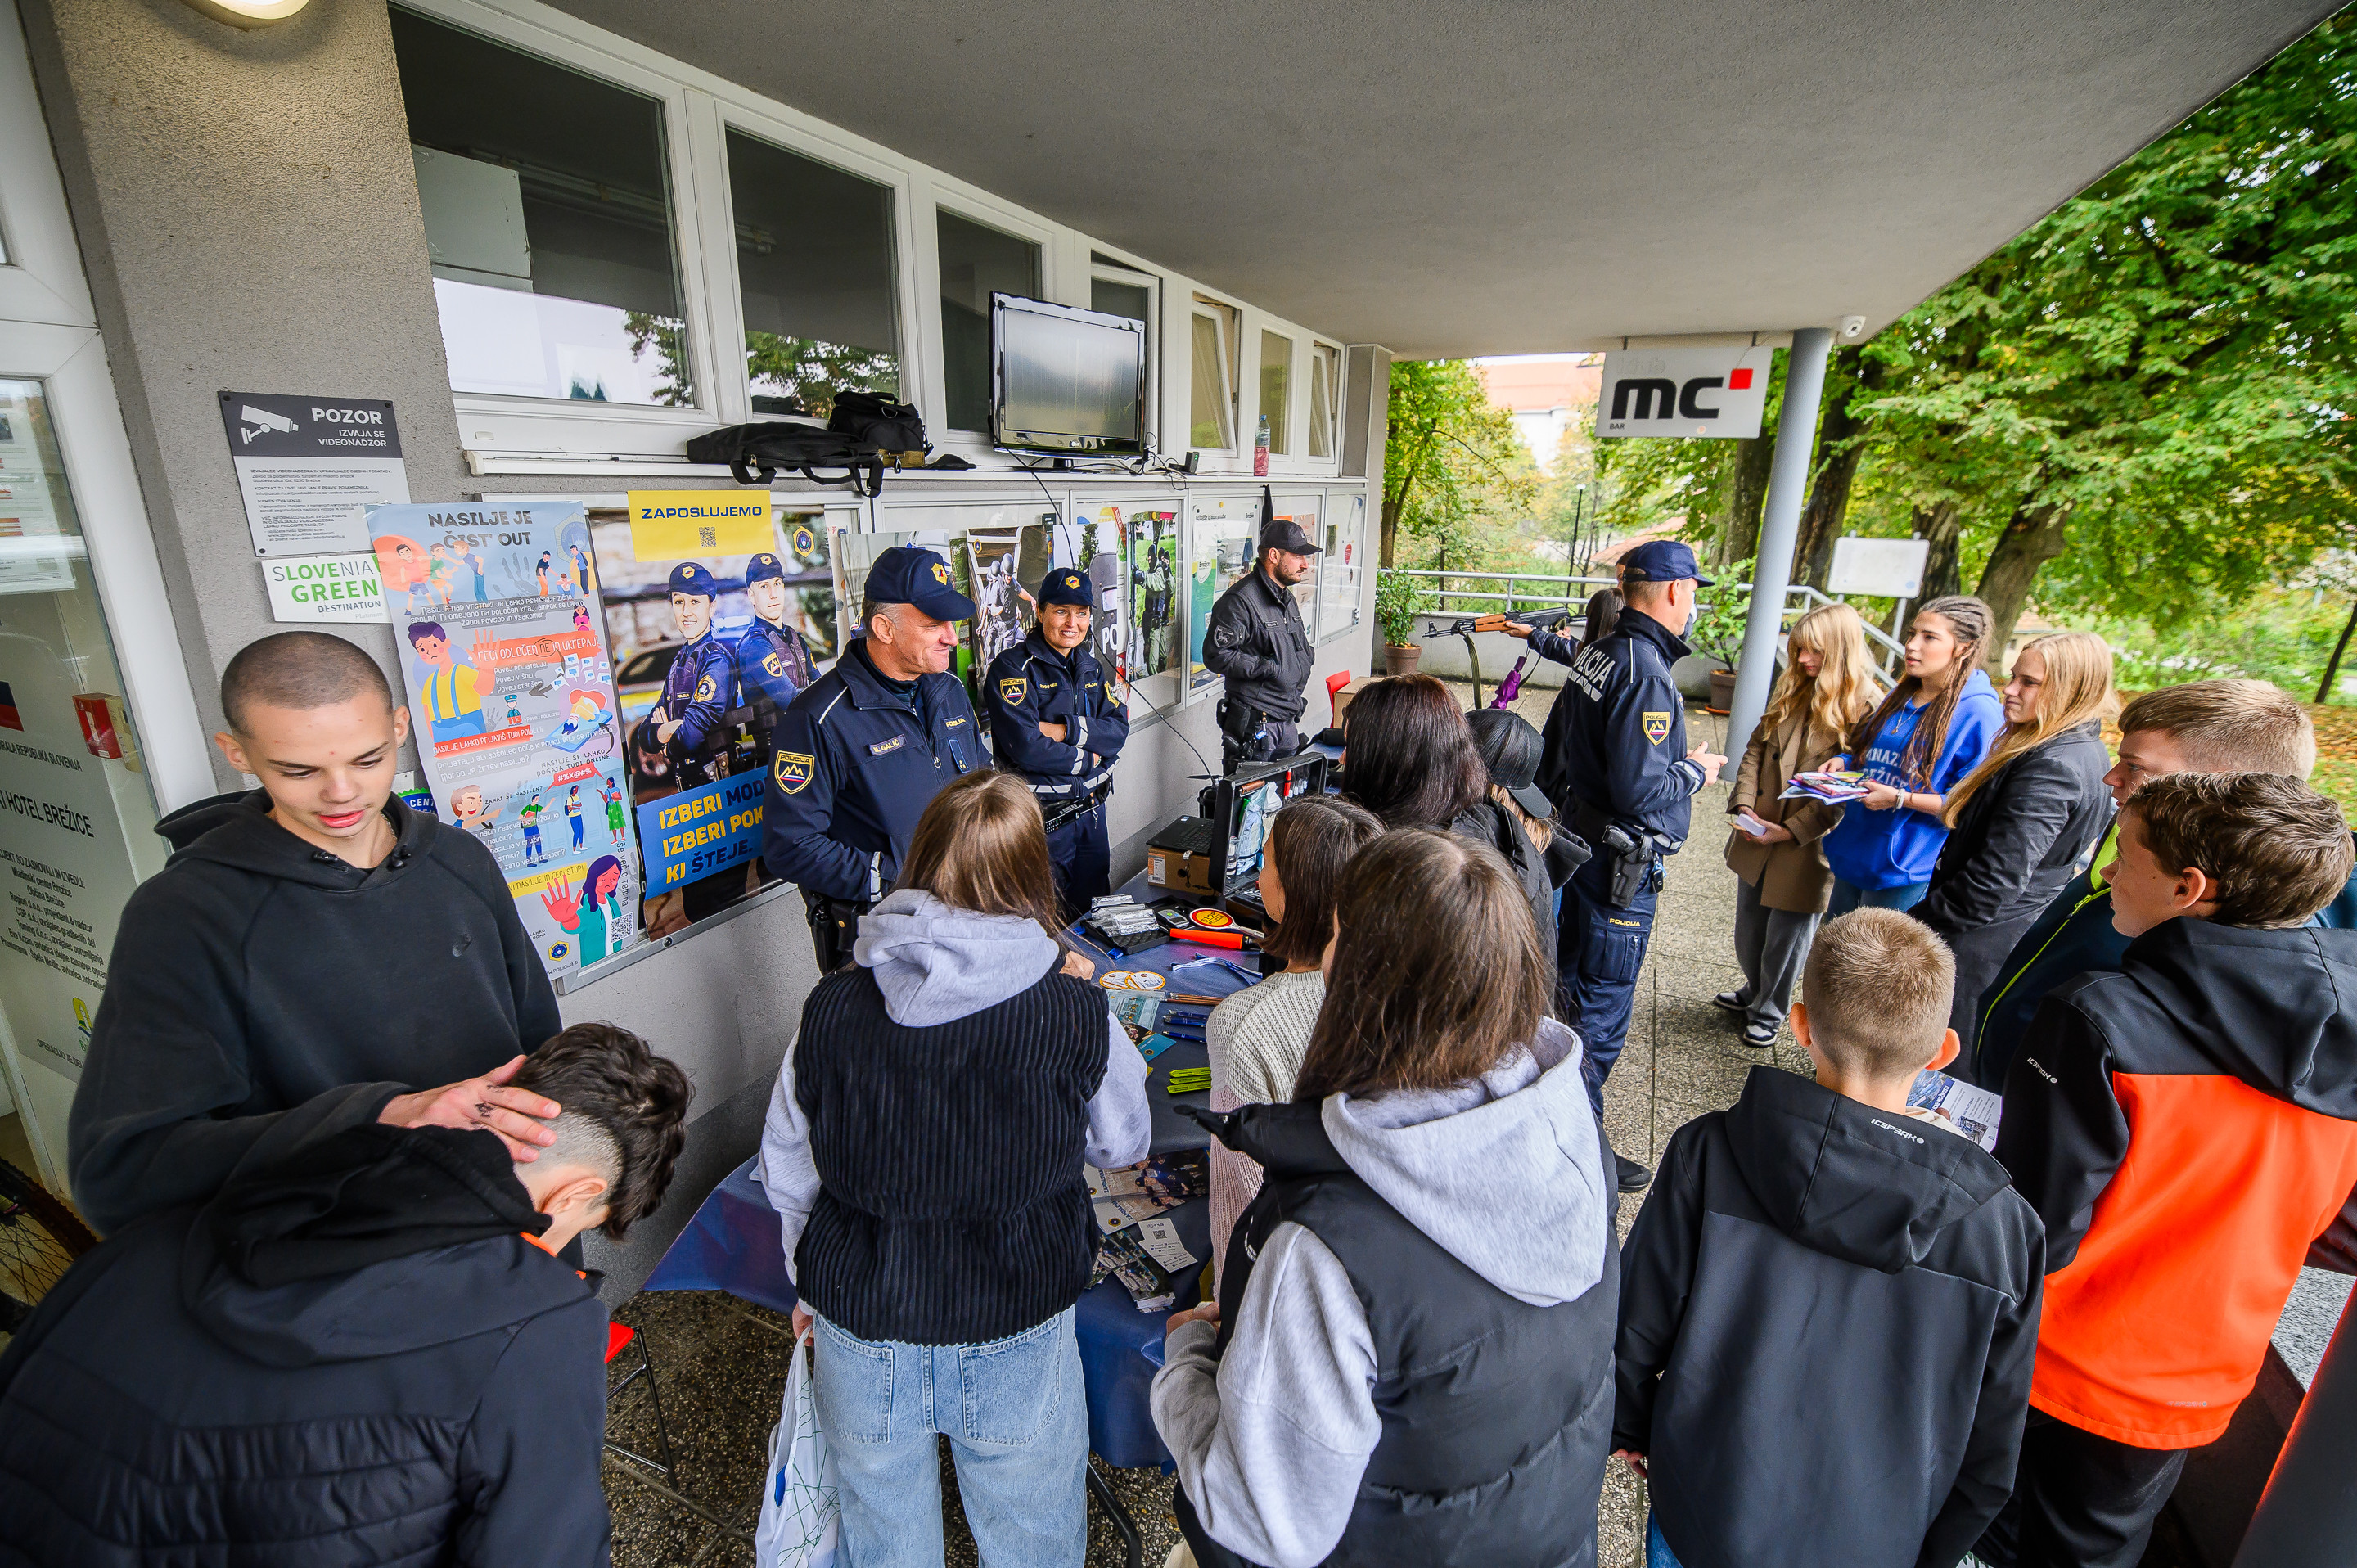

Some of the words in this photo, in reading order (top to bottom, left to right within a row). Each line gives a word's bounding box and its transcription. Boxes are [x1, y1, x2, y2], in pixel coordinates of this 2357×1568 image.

[1611, 377, 1724, 419] mc
[311, 408, 383, 425] POZOR
[338, 430, 372, 438] IZVAJA
[318, 438, 387, 447] VIDEONADZOR
[428, 511, 510, 529] NASILJE
[513, 511, 533, 525] JE
[642, 506, 763, 520] ZAPOSLUJEMO
[498, 532, 532, 547] OUT
[273, 561, 374, 582] SLOVENIA
[291, 579, 379, 603] GREEN
[318, 601, 381, 613] DESTINATION
[1102, 623, 1118, 655] PO
[507, 716, 522, 725] 113
[16, 743, 50, 763] REPUBLIKA
[48, 752, 83, 773] SLOVENIJA
[573, 754, 582, 762] SE
[584, 749, 606, 759] LAHKO
[781, 755, 810, 764] POLICIJA
[536, 766, 564, 777] DOGAJA
[566, 761, 584, 769] TUDI
[485, 796, 503, 805] ZAKAJ
[659, 793, 723, 830] IZBERI
[726, 780, 766, 807] MOD
[7, 791, 44, 822] HOTEL
[43, 804, 94, 838] BREŽICE
[663, 820, 727, 858] IZBERI
[730, 805, 764, 834] POK
[666, 862, 686, 885] KI
[692, 839, 753, 874] ŠTEJE.
[1610, 918, 1641, 927] POLICIJA
